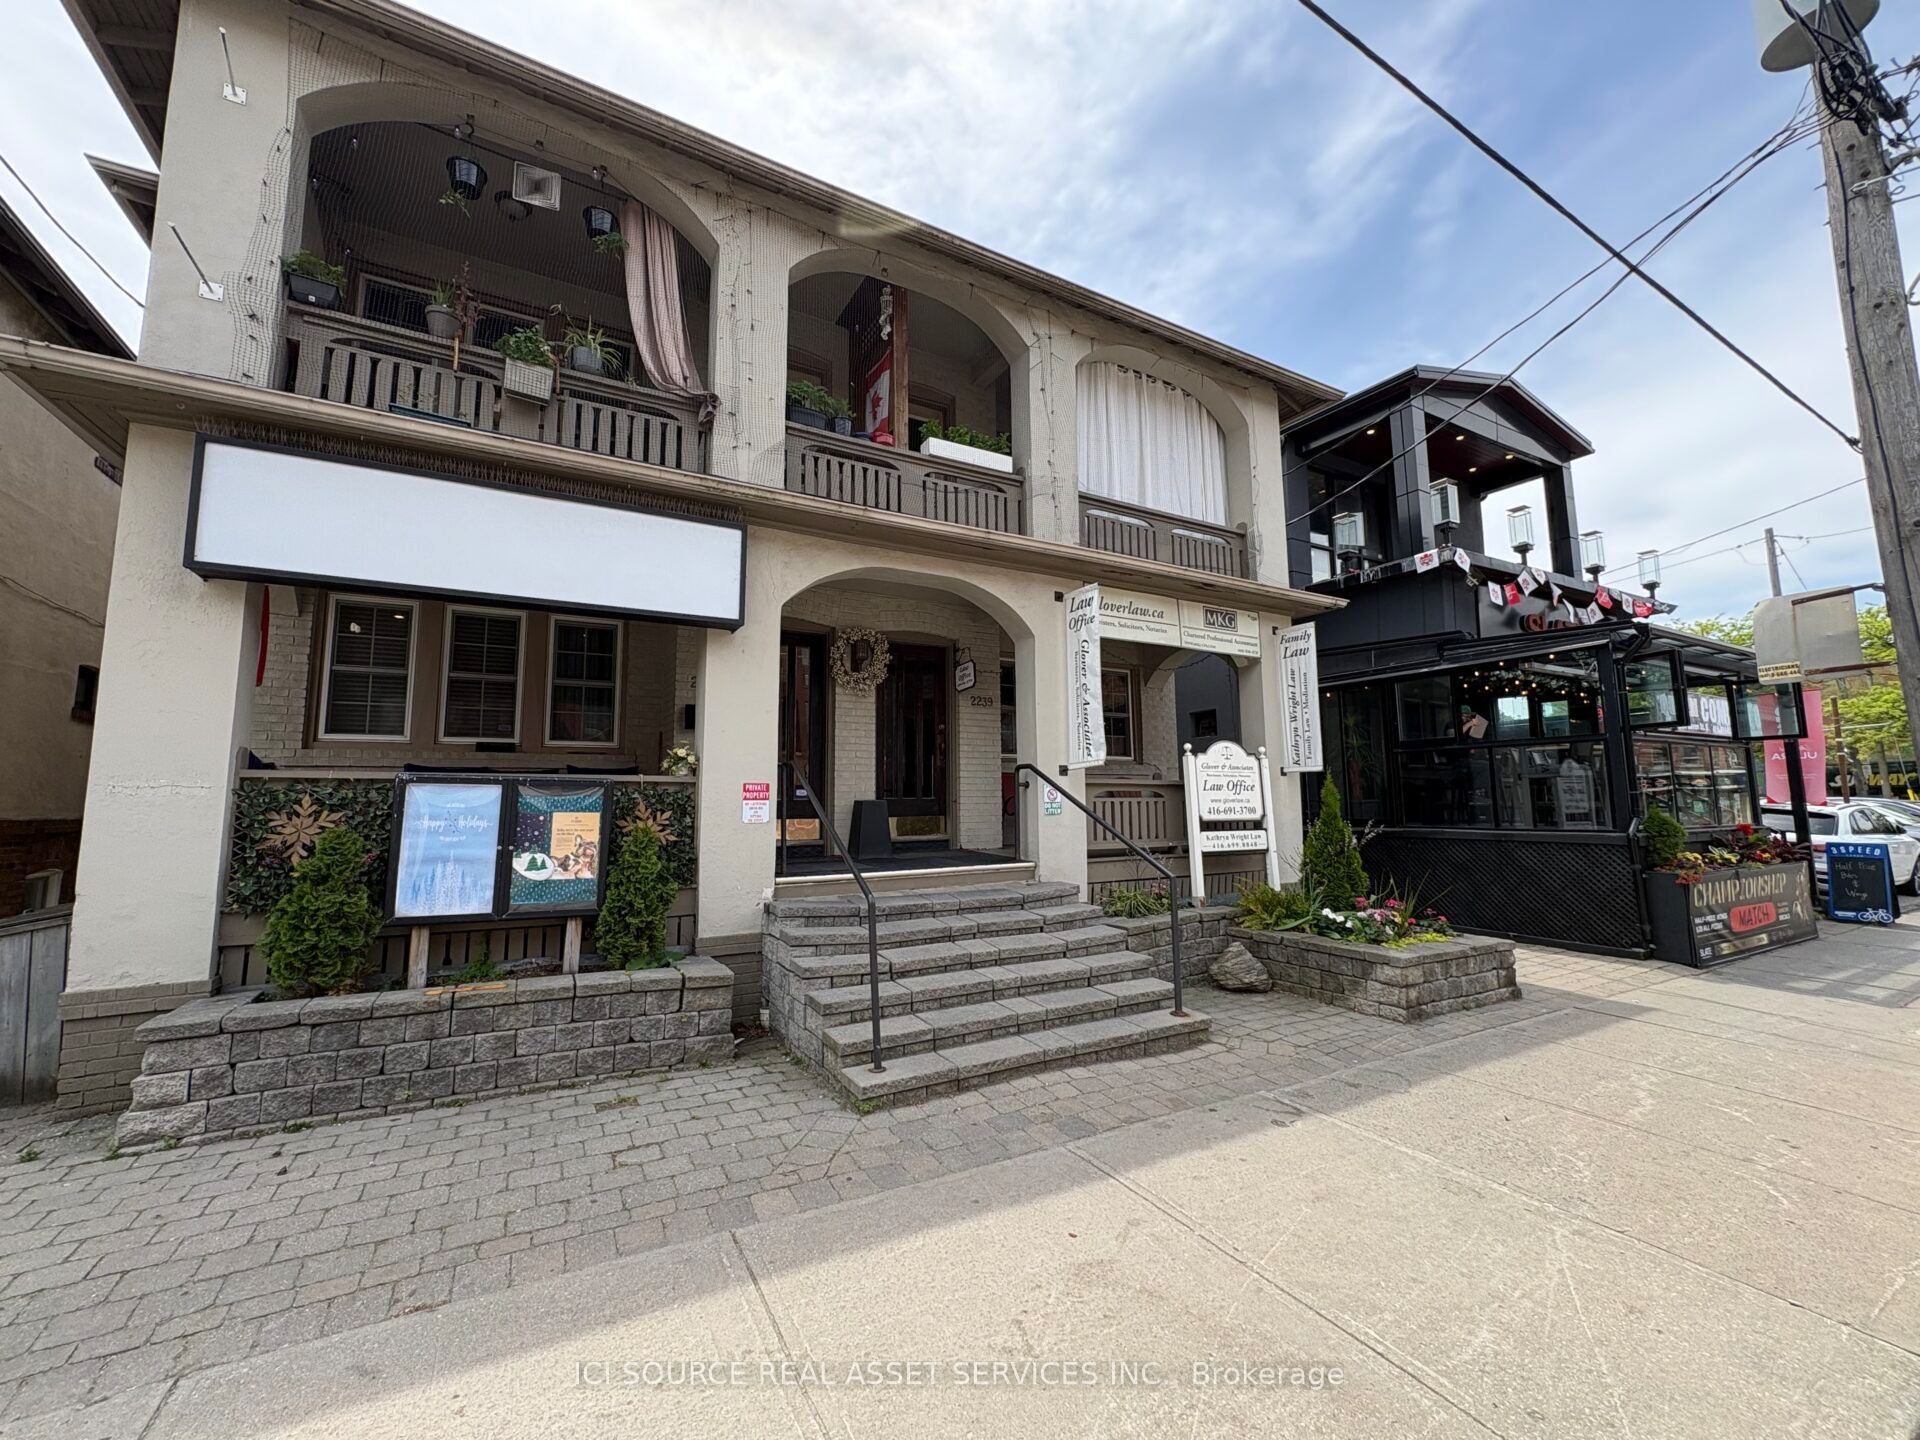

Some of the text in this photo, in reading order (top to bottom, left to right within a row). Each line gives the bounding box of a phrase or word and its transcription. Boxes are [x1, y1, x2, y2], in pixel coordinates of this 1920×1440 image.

[1069, 596, 1094, 613] Law
[1099, 595, 1164, 619] loverlaw.ca
[1068, 613, 1096, 633] Office
[1205, 609, 1236, 629] MKG
[1280, 630, 1312, 645] Family
[1282, 646, 1310, 660] Law
[970, 695, 993, 707] 2239
[1080, 639, 1093, 758] Glover & Associates
[1287, 668, 1301, 766] Kathryn Wright Law
[1201, 762, 1220, 770] Glover
[1221, 762, 1227, 770] &
[745, 783, 768, 791] PRIVATE
[1203, 779, 1256, 795] Law Office
[1829, 772, 1917, 788] SUWAY
[743, 791, 769, 799] PROPERTY
[1207, 806, 1257, 816] 416-691-3700
[418, 815, 490, 832] Happy Holidays
[1206, 832, 1262, 842] Kathryn Wright Law
[1834, 861, 1853, 870] Half
[1693, 872, 1787, 907] CHAMPIONSHIP
[1739, 904, 1769, 927] MATCH
